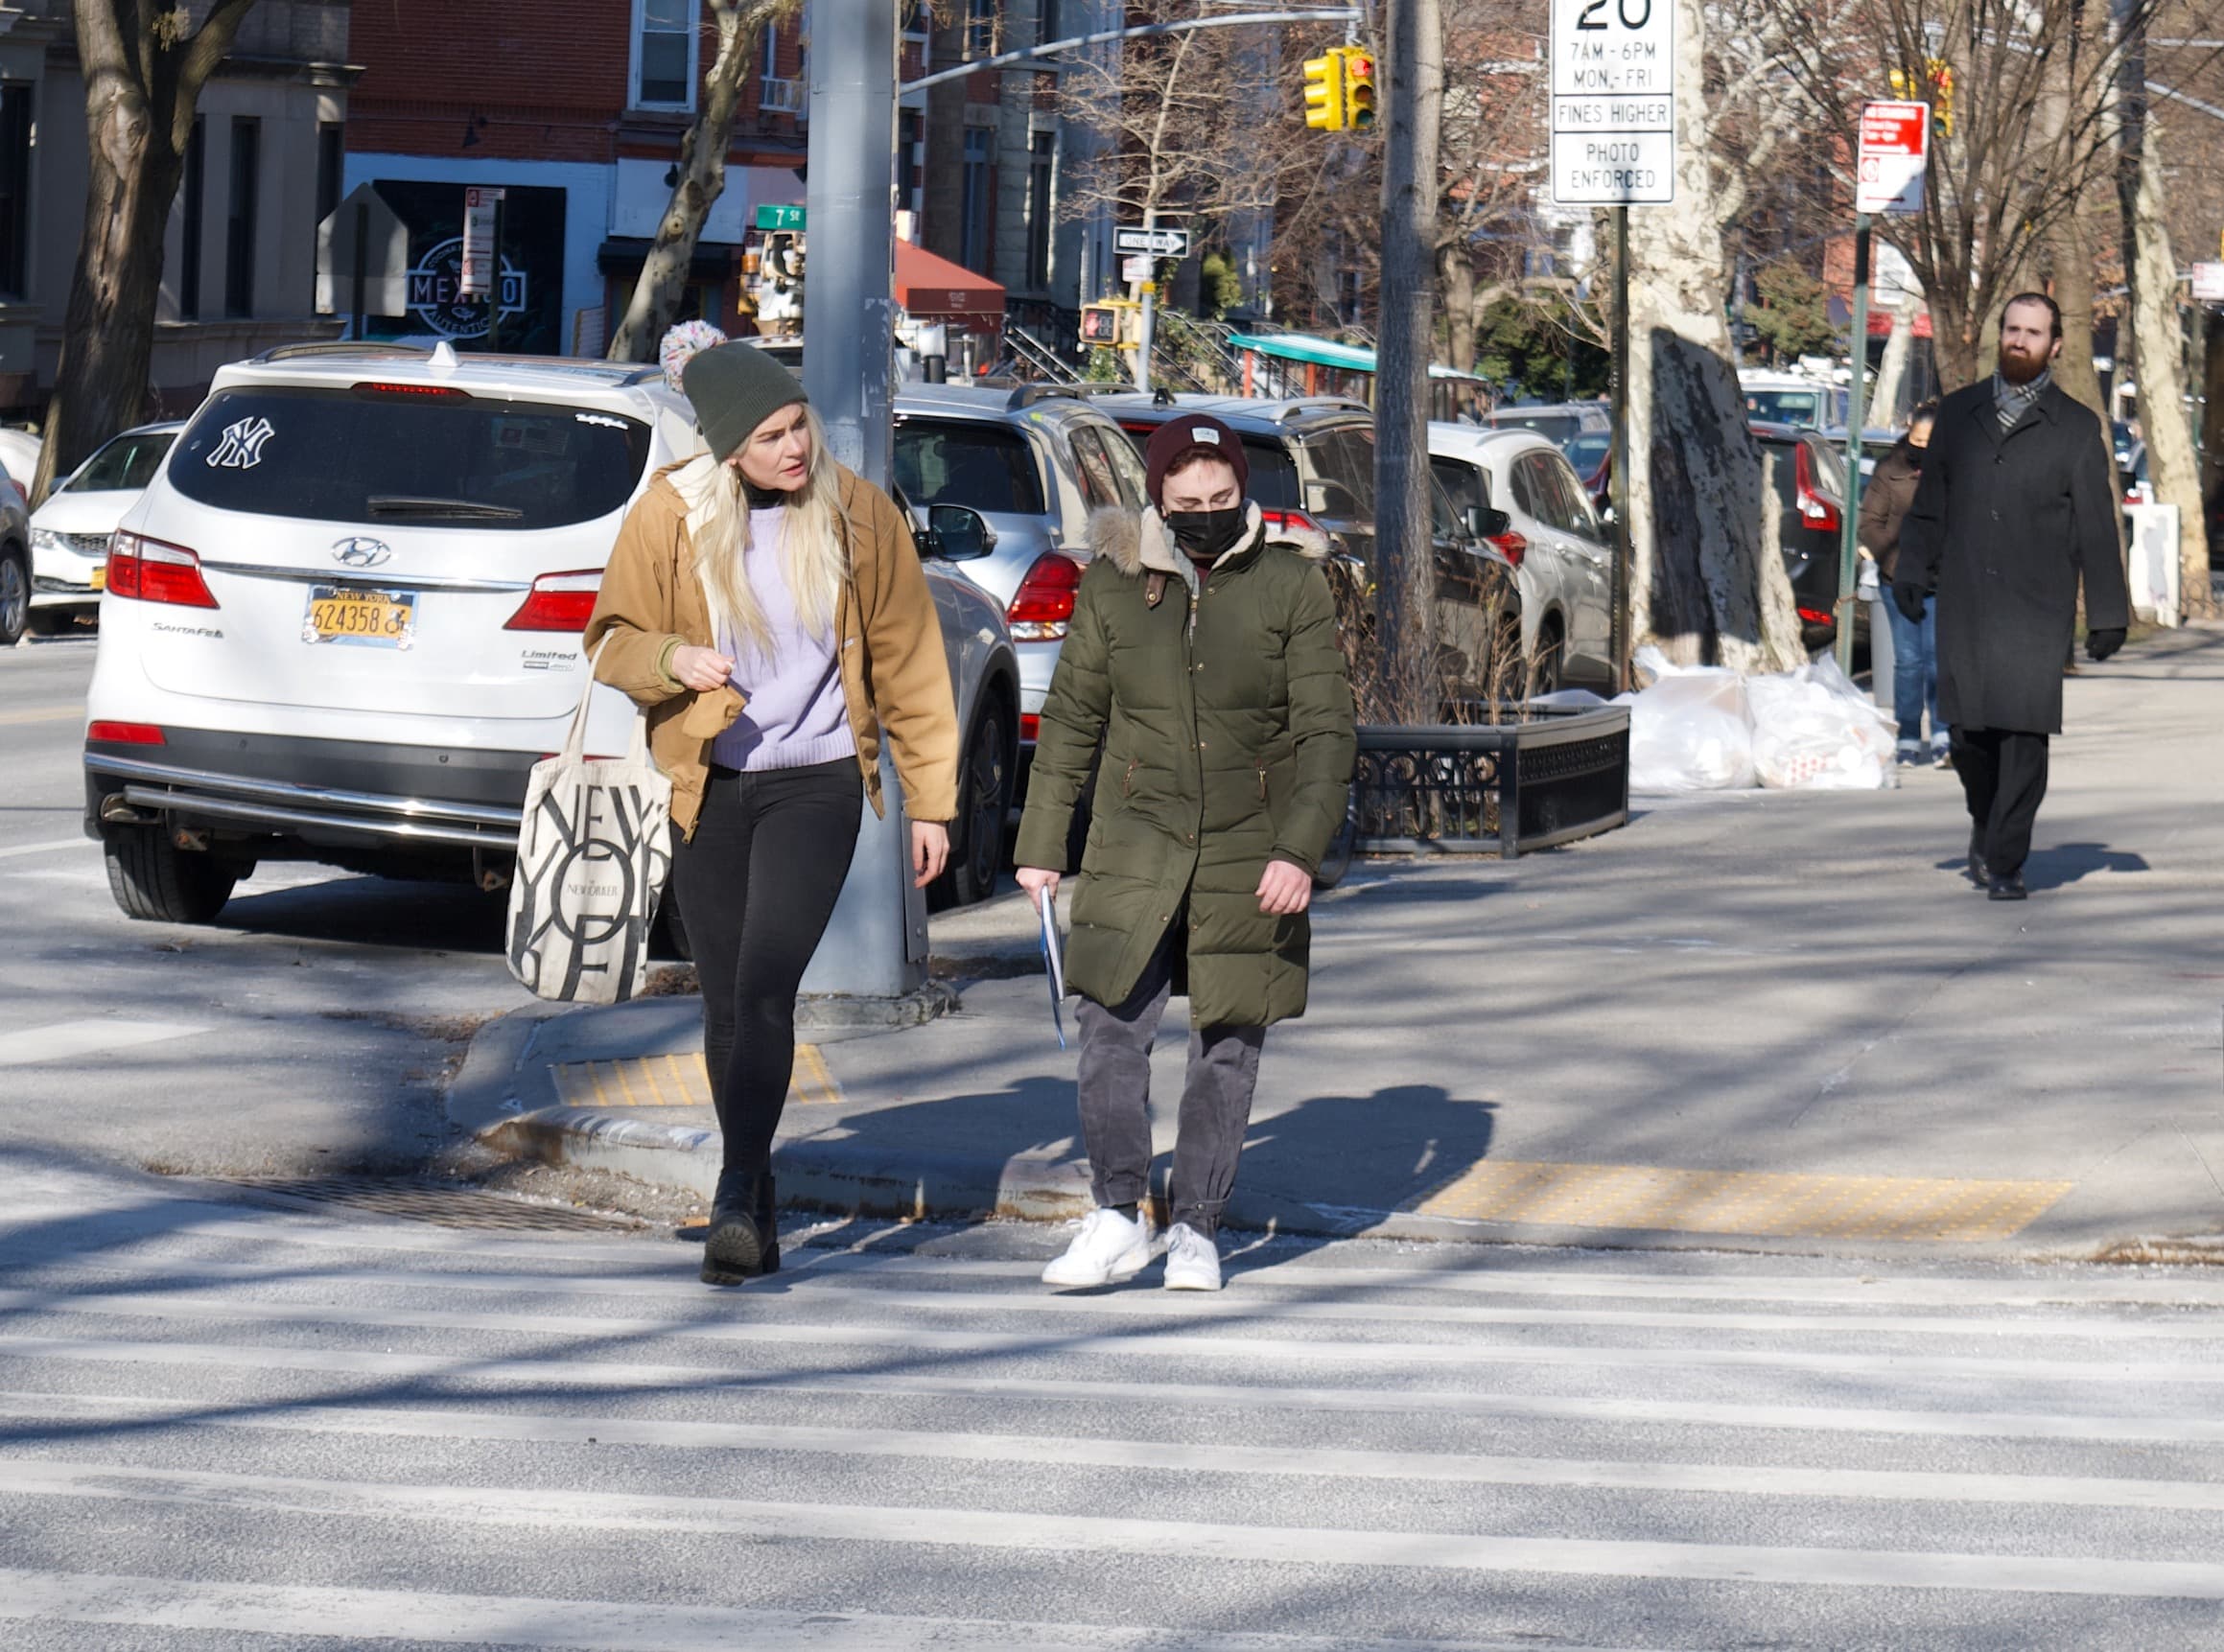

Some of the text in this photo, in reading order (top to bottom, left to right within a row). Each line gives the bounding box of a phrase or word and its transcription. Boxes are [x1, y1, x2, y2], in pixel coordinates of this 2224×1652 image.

[1576, 0, 1651, 30] 20
[1570, 42, 1604, 60] 7AM
[1621, 42, 1656, 60] 6PM
[1626, 69, 1652, 87] FRI
[1558, 104, 1667, 124] FINES HIGHER
[1586, 143, 1640, 163] PHOTO
[1571, 170, 1656, 189] ENFORCED
[775, 209, 785, 226] 7
[1124, 237, 1177, 248] ONE WAY
[337, 591, 391, 605] NEW YORK
[315, 603, 381, 633] 624358
[522, 650, 577, 661] Limited
